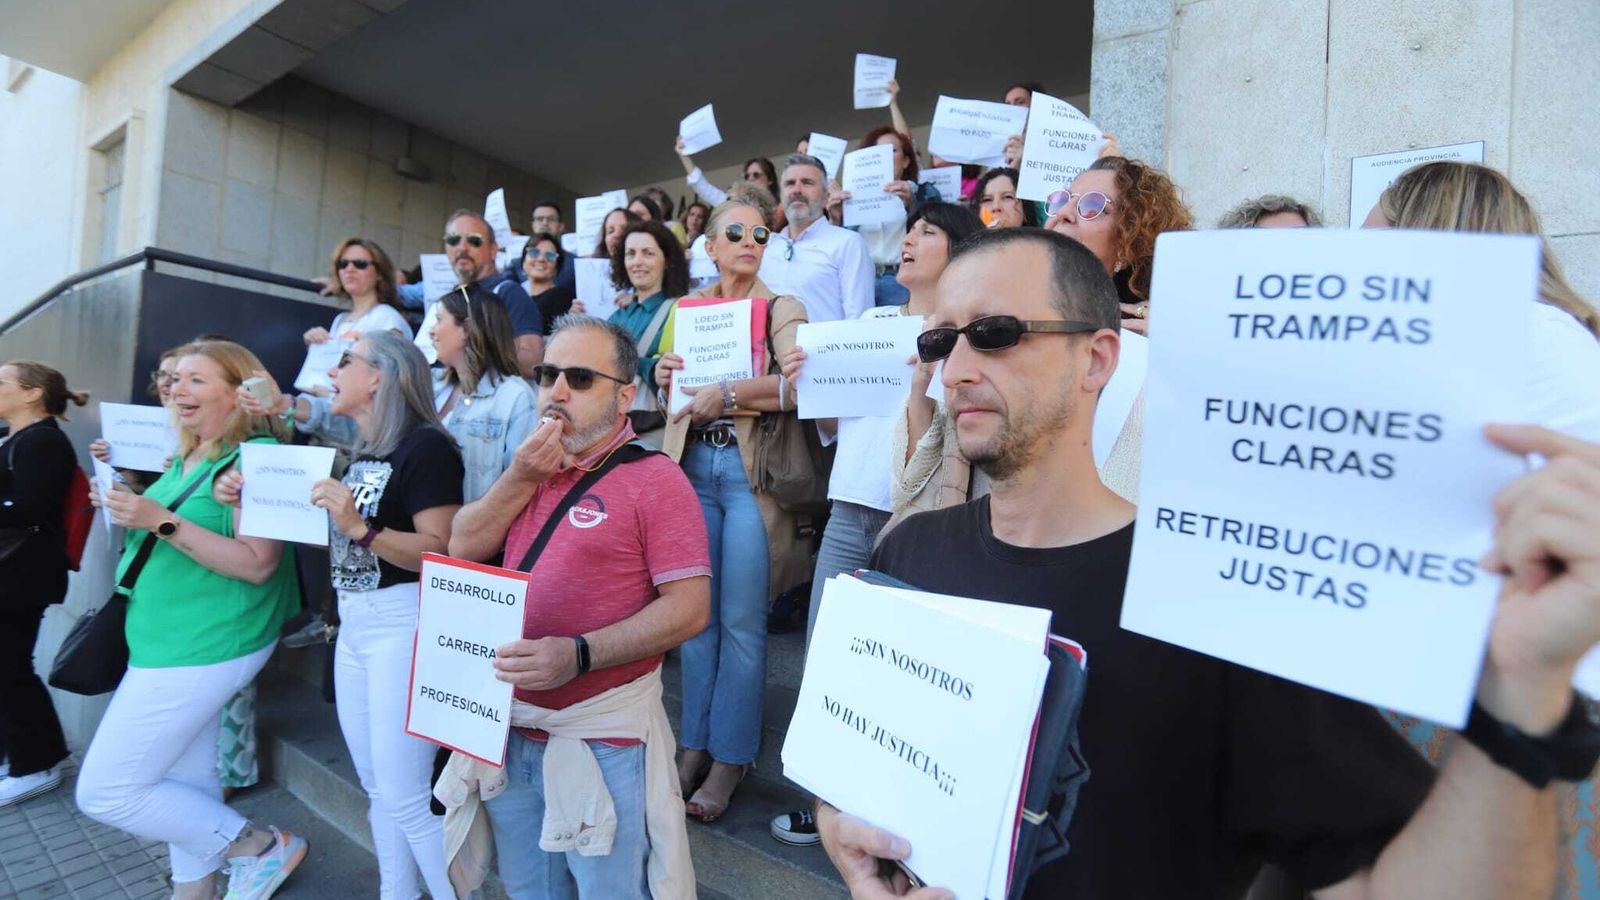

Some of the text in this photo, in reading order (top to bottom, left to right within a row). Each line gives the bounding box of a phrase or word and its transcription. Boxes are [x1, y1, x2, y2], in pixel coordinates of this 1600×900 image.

[1042, 128, 1097, 142] FUNCIONES
[1048, 140, 1087, 152] CLARAS
[1025, 160, 1089, 174] RETRIBUCION
[1371, 151, 1462, 168] AUDIENCIA PROVINCIAL
[1043, 174, 1073, 184] JUSTA
[1235, 274, 1432, 303] LOEO SIN
[694, 320, 735, 333] TRAMPAS
[695, 312, 735, 324] LOEO SIN
[1228, 313, 1432, 345] TRAMPAS
[689, 340, 738, 354] FUNCIONES
[843, 341, 895, 352] NOSOTROS
[696, 351, 731, 363] CLARAS
[677, 370, 749, 385] RETRIBUCIONES
[813, 376, 828, 385] NO
[828, 376, 847, 385] HAY
[1204, 397, 1444, 443] FUNCIONES
[1231, 438, 1397, 480] CLARAS
[1155, 507, 1480, 587] RETRIBUCIONES
[431, 576, 516, 606] DESARROLLO
[1219, 557, 1369, 609] JUSTAS
[437, 635, 497, 660] CARRERA
[850, 636, 975, 701] ¡¡¡SIN NOSOTROS
[420, 686, 502, 723] PROFESIONAL
[821, 695, 957, 797] NO HAY JUSTICIA¡¡¡
